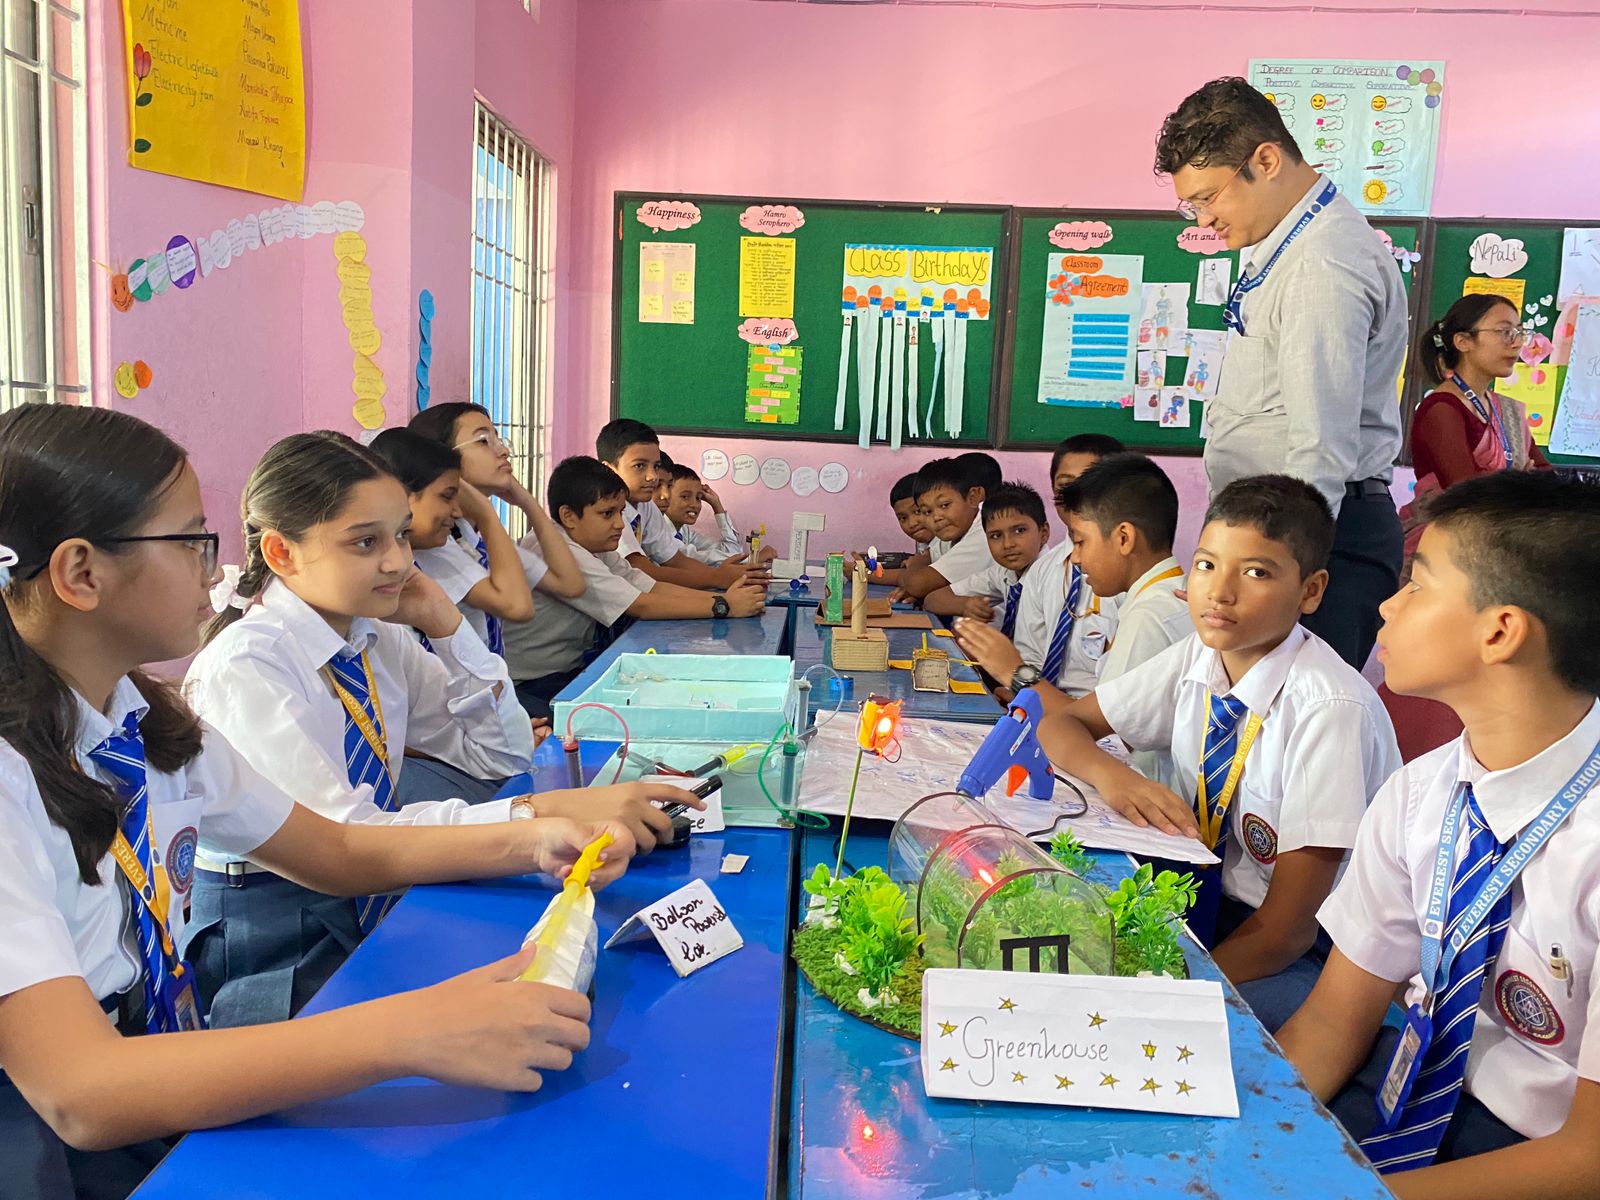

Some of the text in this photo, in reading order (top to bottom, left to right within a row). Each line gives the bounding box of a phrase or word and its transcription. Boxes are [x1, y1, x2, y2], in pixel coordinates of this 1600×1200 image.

[648, 206, 696, 220] Happiness
[763, 209, 787, 219] Hamro
[1054, 229, 1089, 240] Opening
[1184, 233, 1216, 241] Art and
[1287, 216, 1311, 242] EVEREST
[1065, 257, 1099, 269] Classroom
[1080, 275, 1127, 295] Agreement
[753, 326, 788, 339] English
[113, 838, 144, 885] EVERES
[1429, 799, 1459, 917] EVEREST SECO
[1460, 875, 1504, 934] EVEREST
[1500, 801, 1567, 877] SECONDARY
[650, 899, 704, 931] Balloon
[963, 1016, 1109, 1086] Greenhouse
